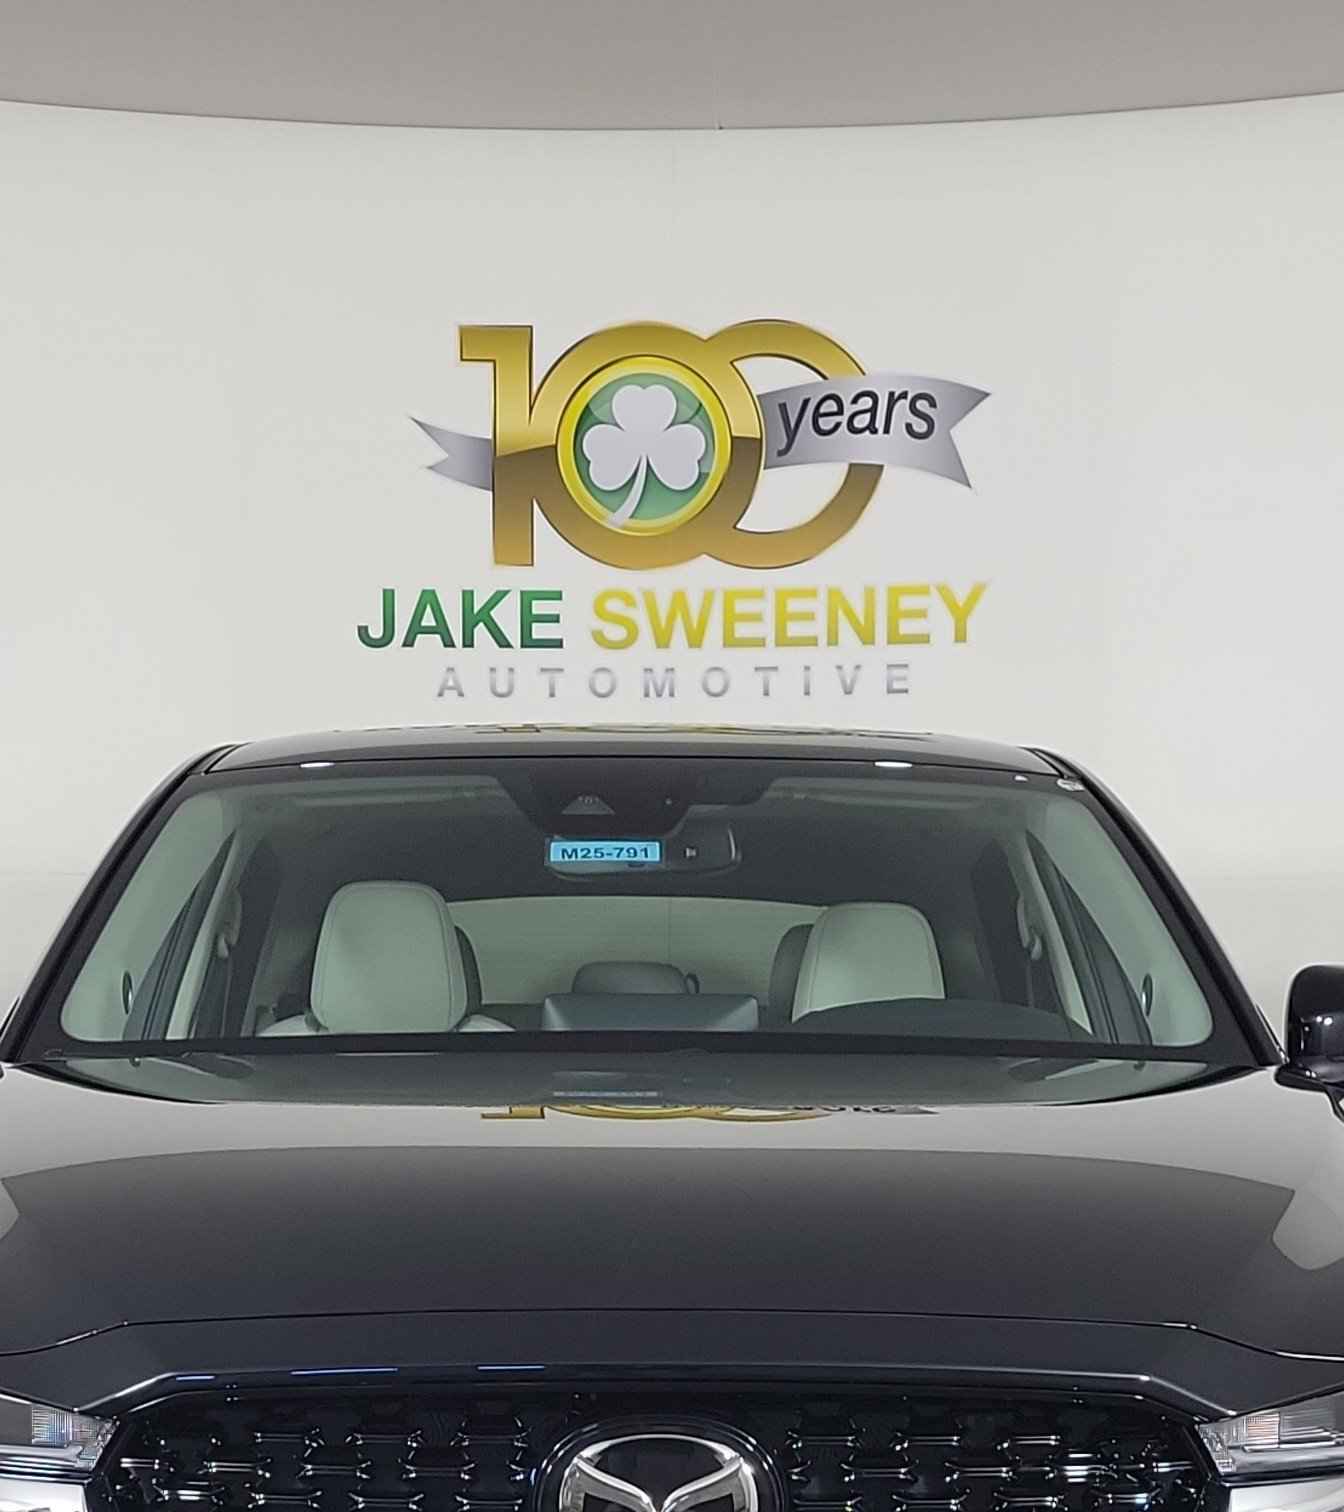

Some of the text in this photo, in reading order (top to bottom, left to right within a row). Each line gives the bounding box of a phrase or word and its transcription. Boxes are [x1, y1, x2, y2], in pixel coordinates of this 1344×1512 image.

[775, 388, 938, 457] years
[357, 582, 988, 650] JAKE SWEENEY
[437, 664, 910, 698] AUTOMOTIVE
[561, 847, 649, 860] M25-791
